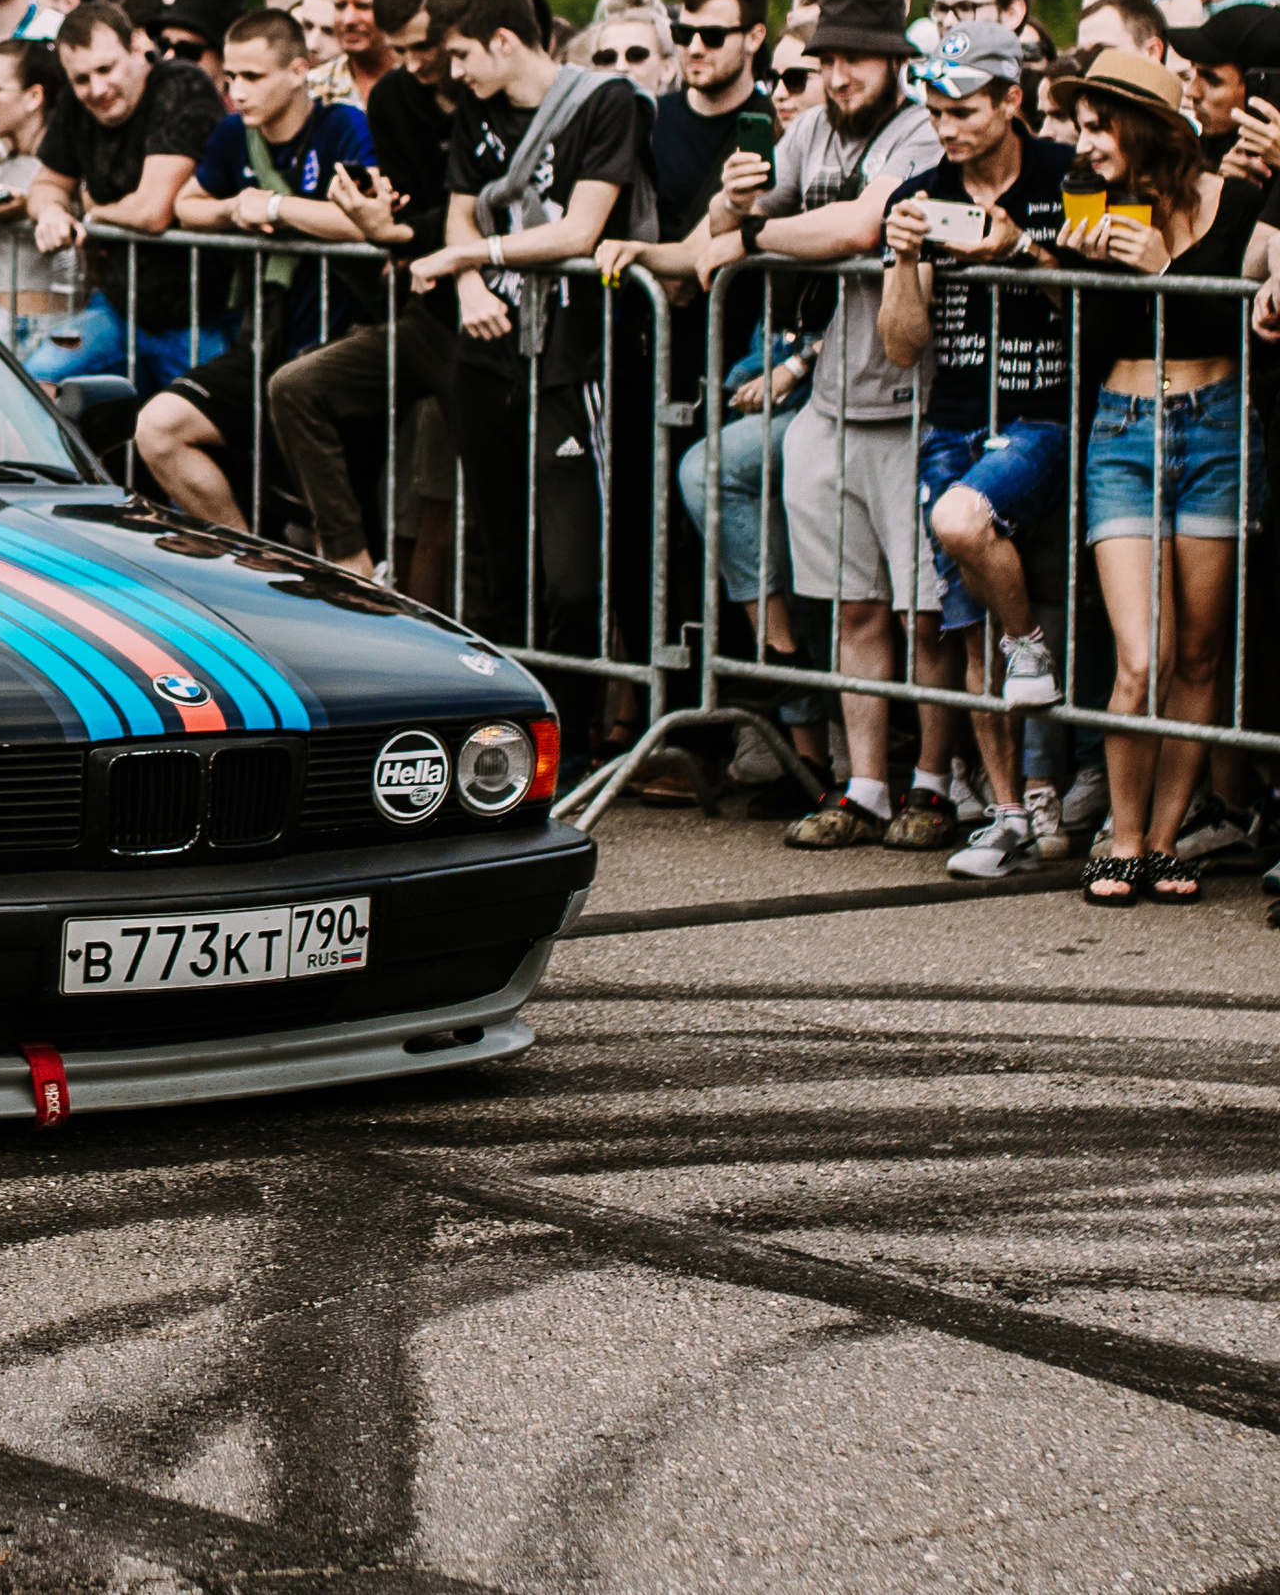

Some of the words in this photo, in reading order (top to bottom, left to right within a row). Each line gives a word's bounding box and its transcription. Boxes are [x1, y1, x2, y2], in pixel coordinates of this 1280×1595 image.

[380, 759, 443, 785] Hella
[295, 904, 358, 953] 790
[307, 950, 340, 969] RUS
